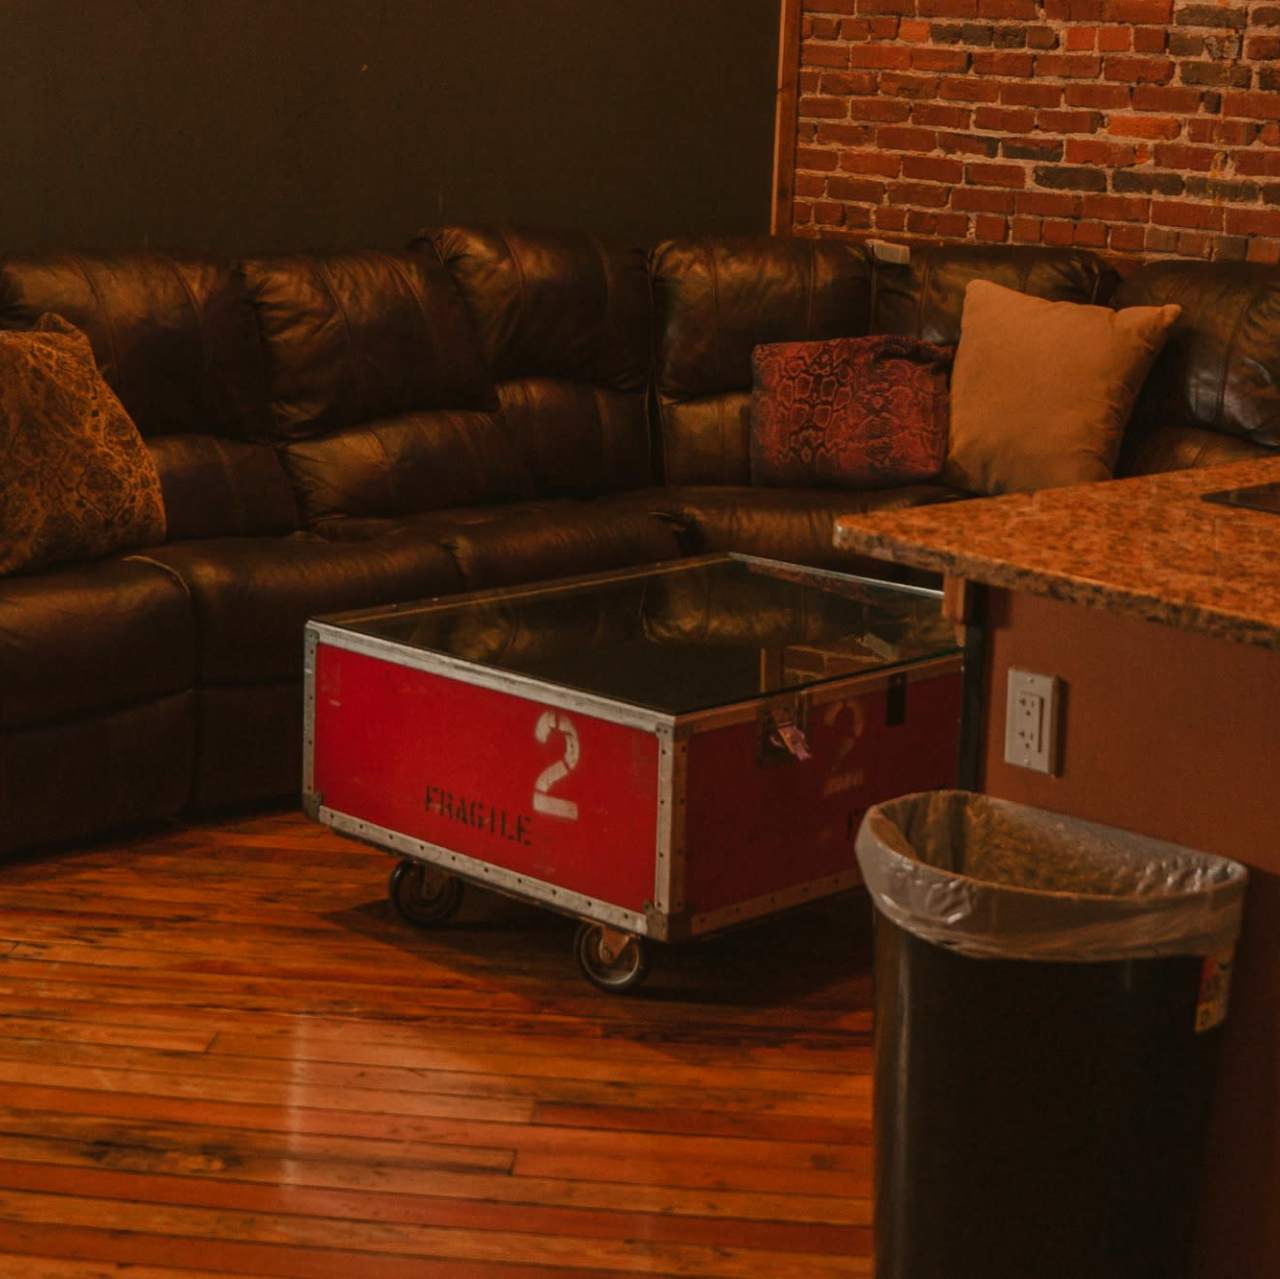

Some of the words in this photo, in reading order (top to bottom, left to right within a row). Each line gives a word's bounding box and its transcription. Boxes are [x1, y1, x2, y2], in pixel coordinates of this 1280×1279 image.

[533, 711, 580, 820] 2
[824, 701, 865, 798] 2
[424, 785, 532, 847] FRAGILE
